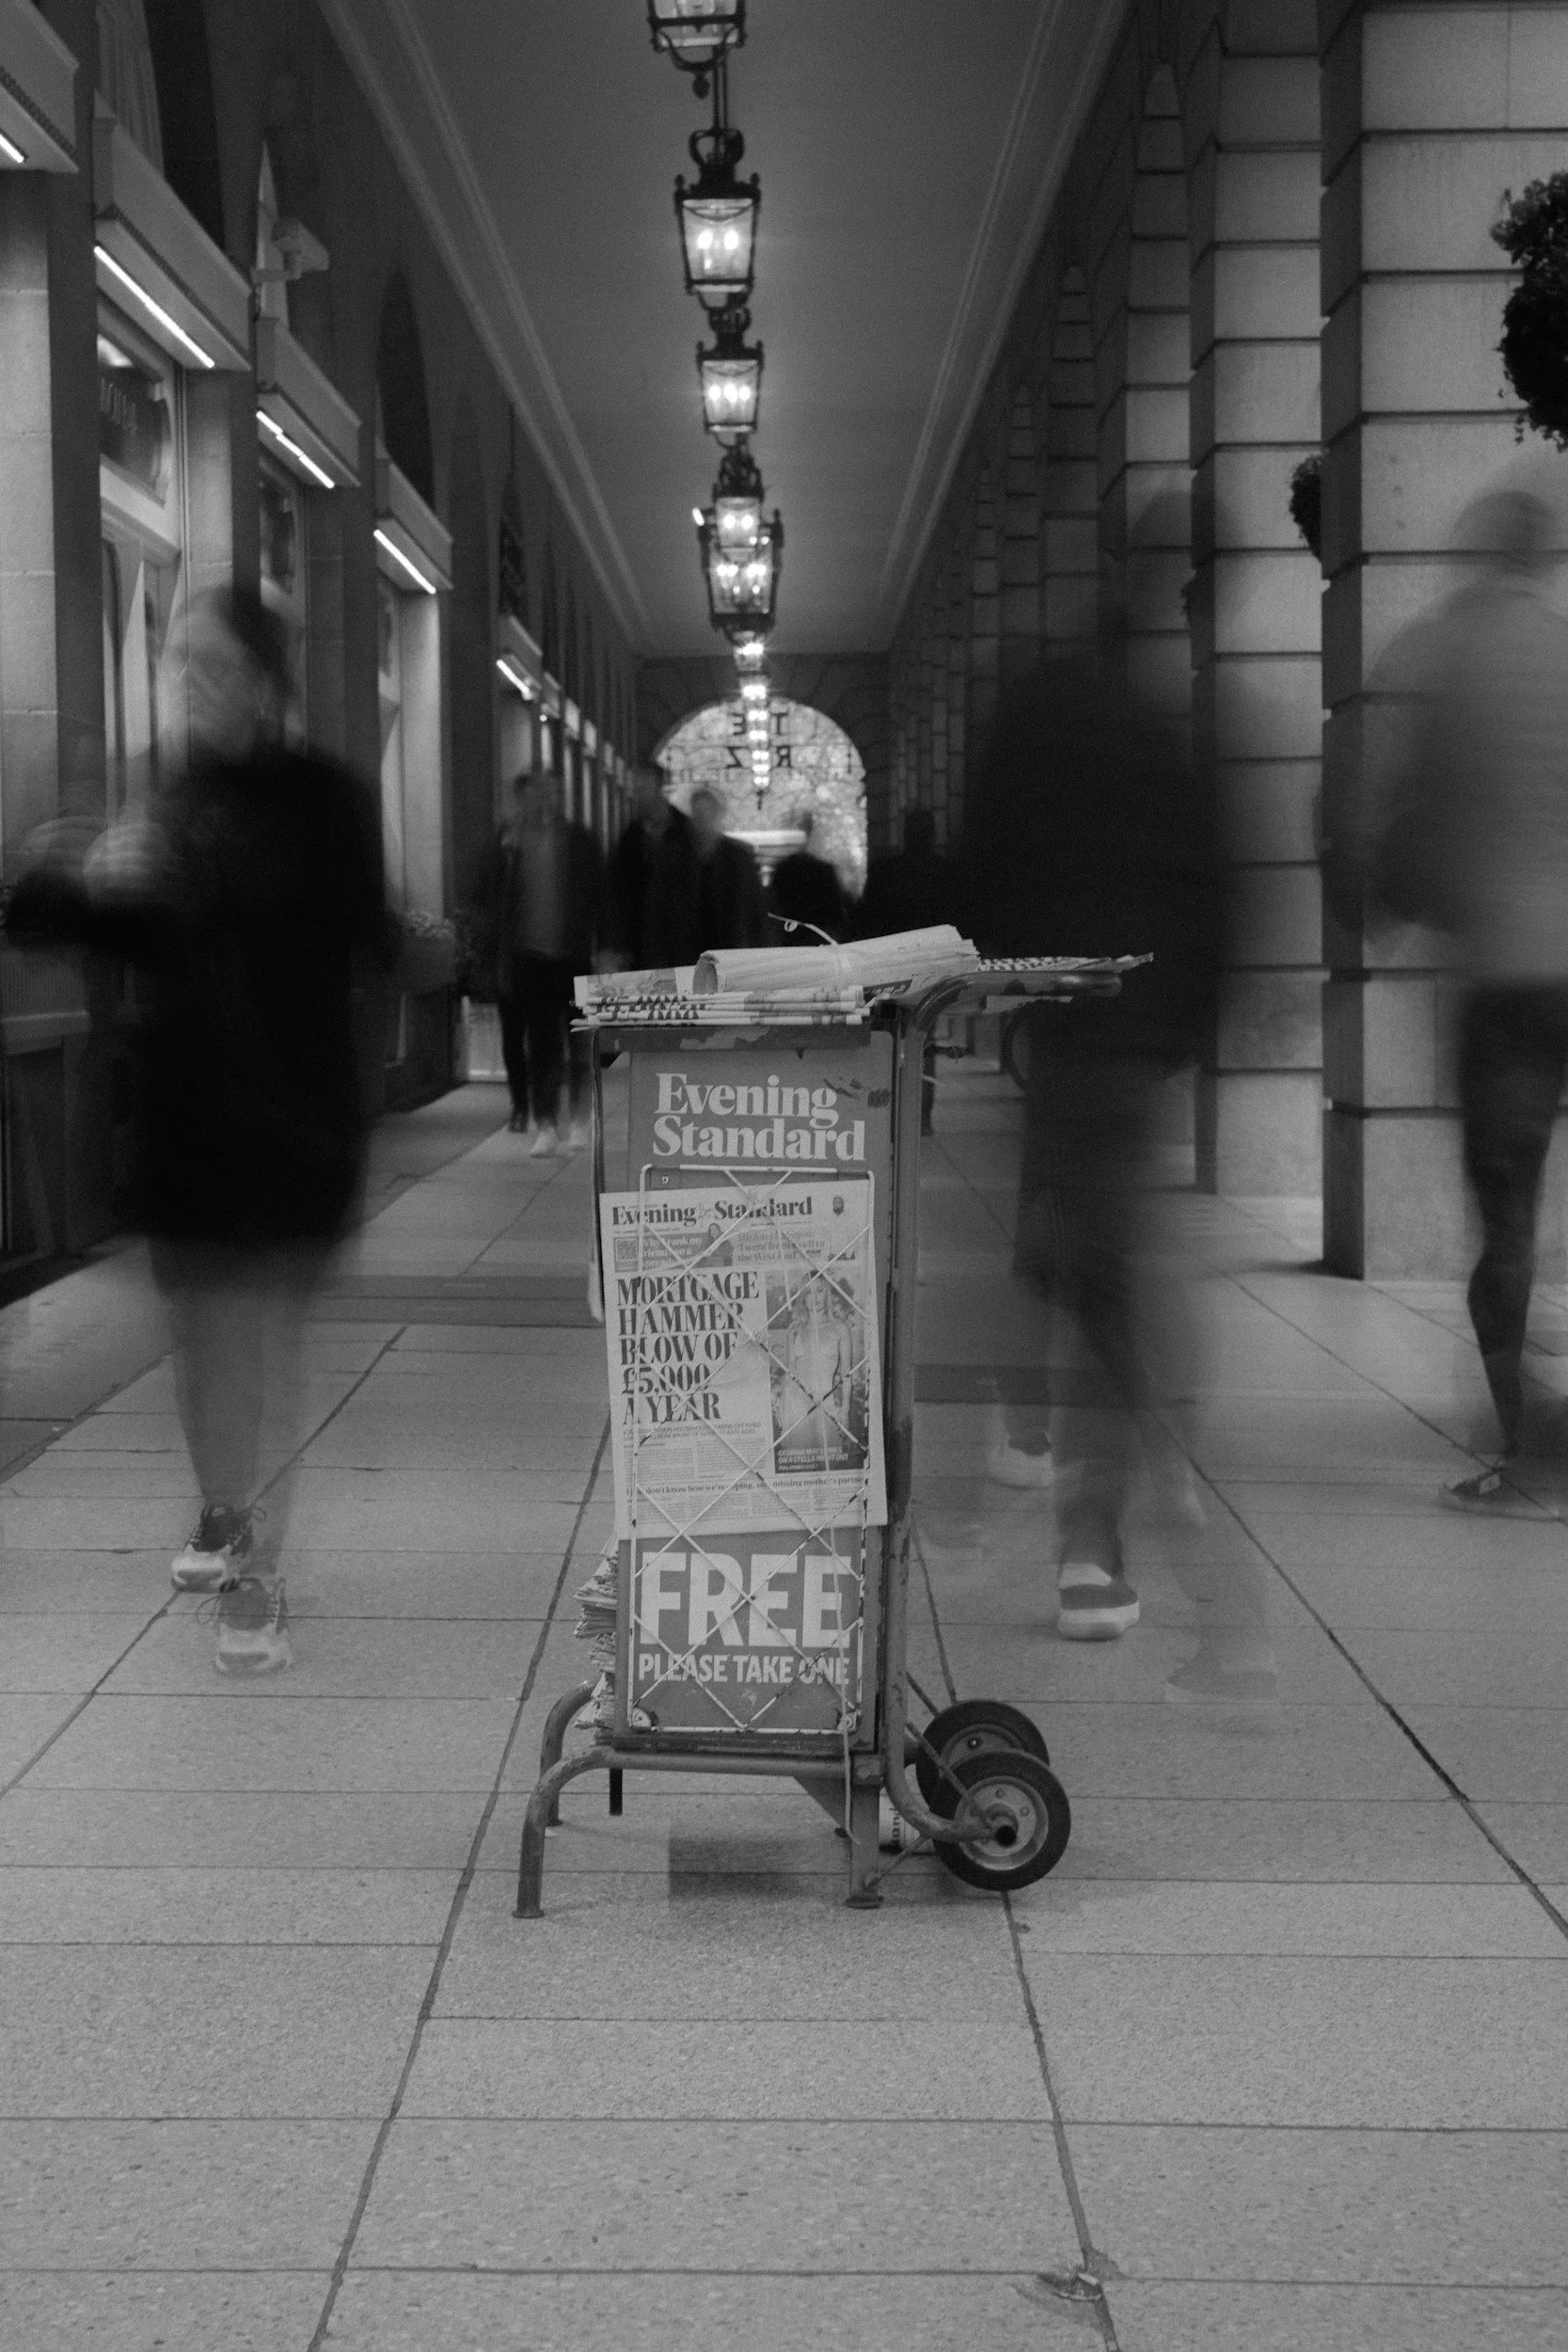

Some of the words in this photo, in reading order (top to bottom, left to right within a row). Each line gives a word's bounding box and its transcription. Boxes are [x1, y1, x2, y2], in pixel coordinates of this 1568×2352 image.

[655, 1073, 839, 1129] Evening
[653, 1115, 866, 1161] Standard
[611, 1203, 697, 1226] Evening
[715, 1196, 813, 1220] Standard
[617, 1271, 759, 1307] MORTGAGE
[619, 1302, 743, 1335] HAMMER
[620, 1334, 699, 1365] BLOW
[705, 1332, 738, 1361] OF
[622, 1363, 712, 1395] £5,000
[623, 1397, 641, 1425] A
[645, 1392, 721, 1424] YEAR
[640, 1551, 851, 1648] FREE
[639, 1653, 728, 1683] PLEASE
[733, 1654, 794, 1684] TAKE
[798, 1657, 850, 1686] ONE
